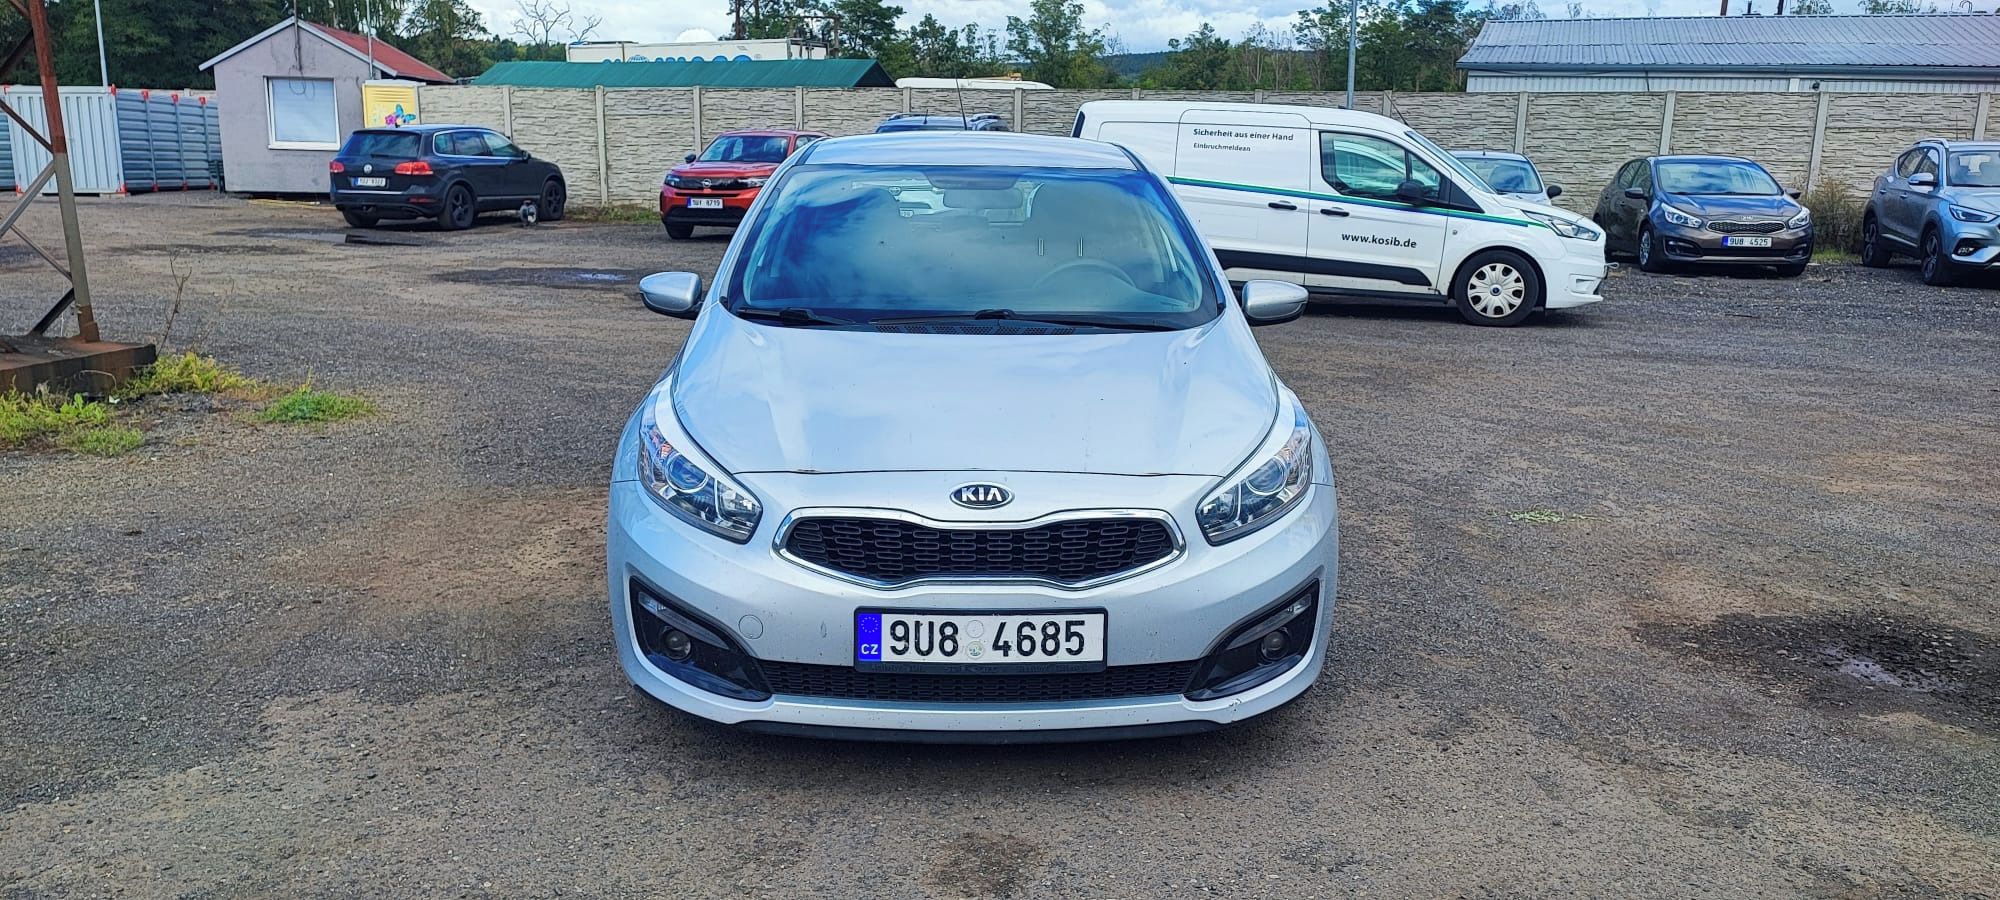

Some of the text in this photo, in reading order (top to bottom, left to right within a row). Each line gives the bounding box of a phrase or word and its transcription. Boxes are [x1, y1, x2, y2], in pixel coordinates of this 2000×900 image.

[1193, 128, 1233, 138] Sicherheit
[1249, 132, 1270, 140] einer
[1272, 133, 1294, 141] Hand
[1341, 233, 1417, 249] www.kosib.de
[1749, 238, 1768, 246] 4525
[961, 487, 1003, 502] KIA
[889, 620, 1085, 657] 9U8 4685
[860, 643, 879, 655] CZ
